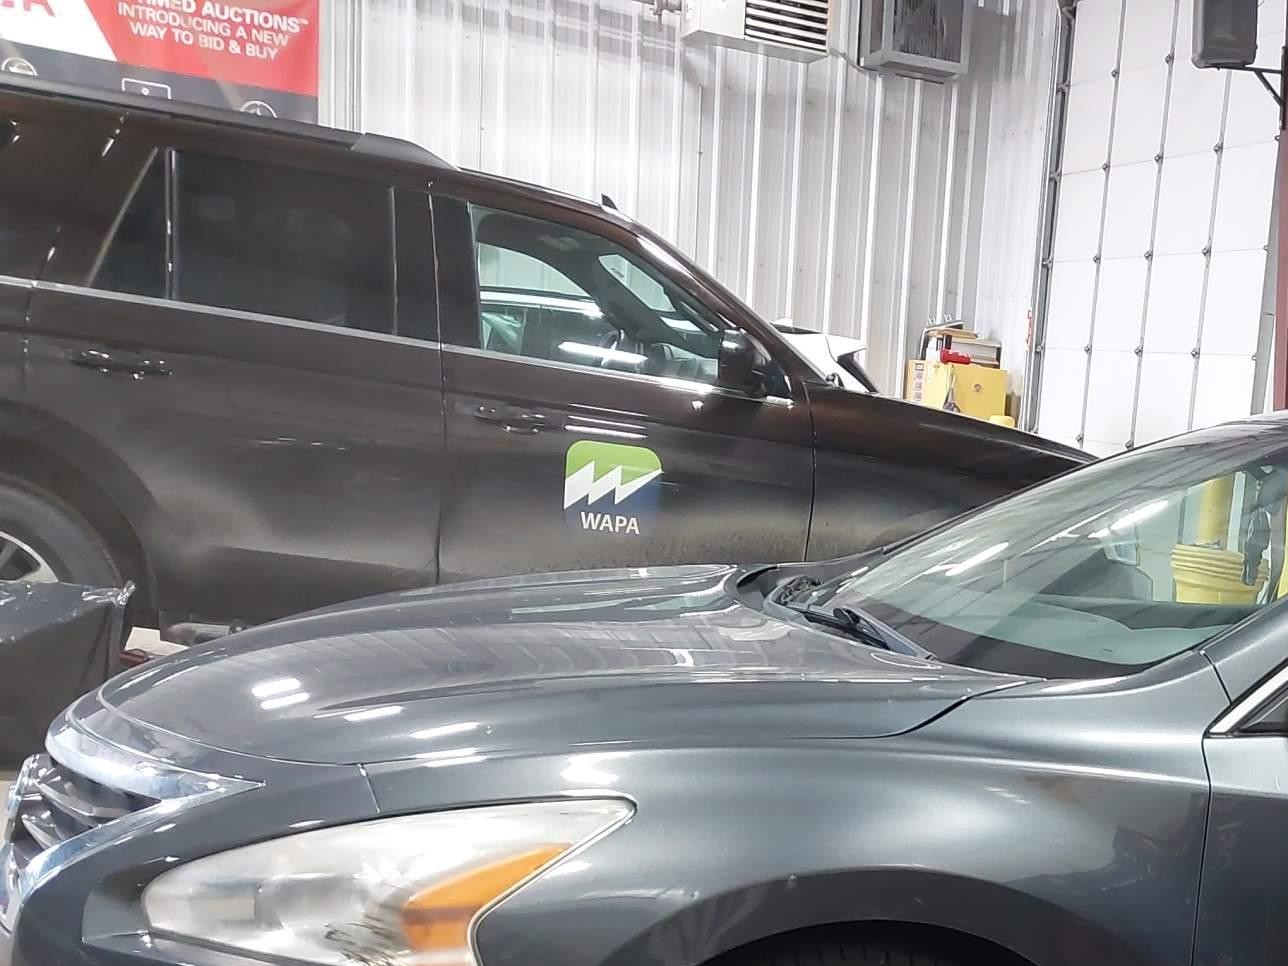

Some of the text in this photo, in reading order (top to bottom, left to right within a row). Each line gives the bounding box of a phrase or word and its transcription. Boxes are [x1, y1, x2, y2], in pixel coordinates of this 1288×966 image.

[118, 5, 289, 47] INTRODUCING A NEW
[130, 21, 279, 62] WAY TO BID & BUY
[580, 511, 640, 535] WAPA
